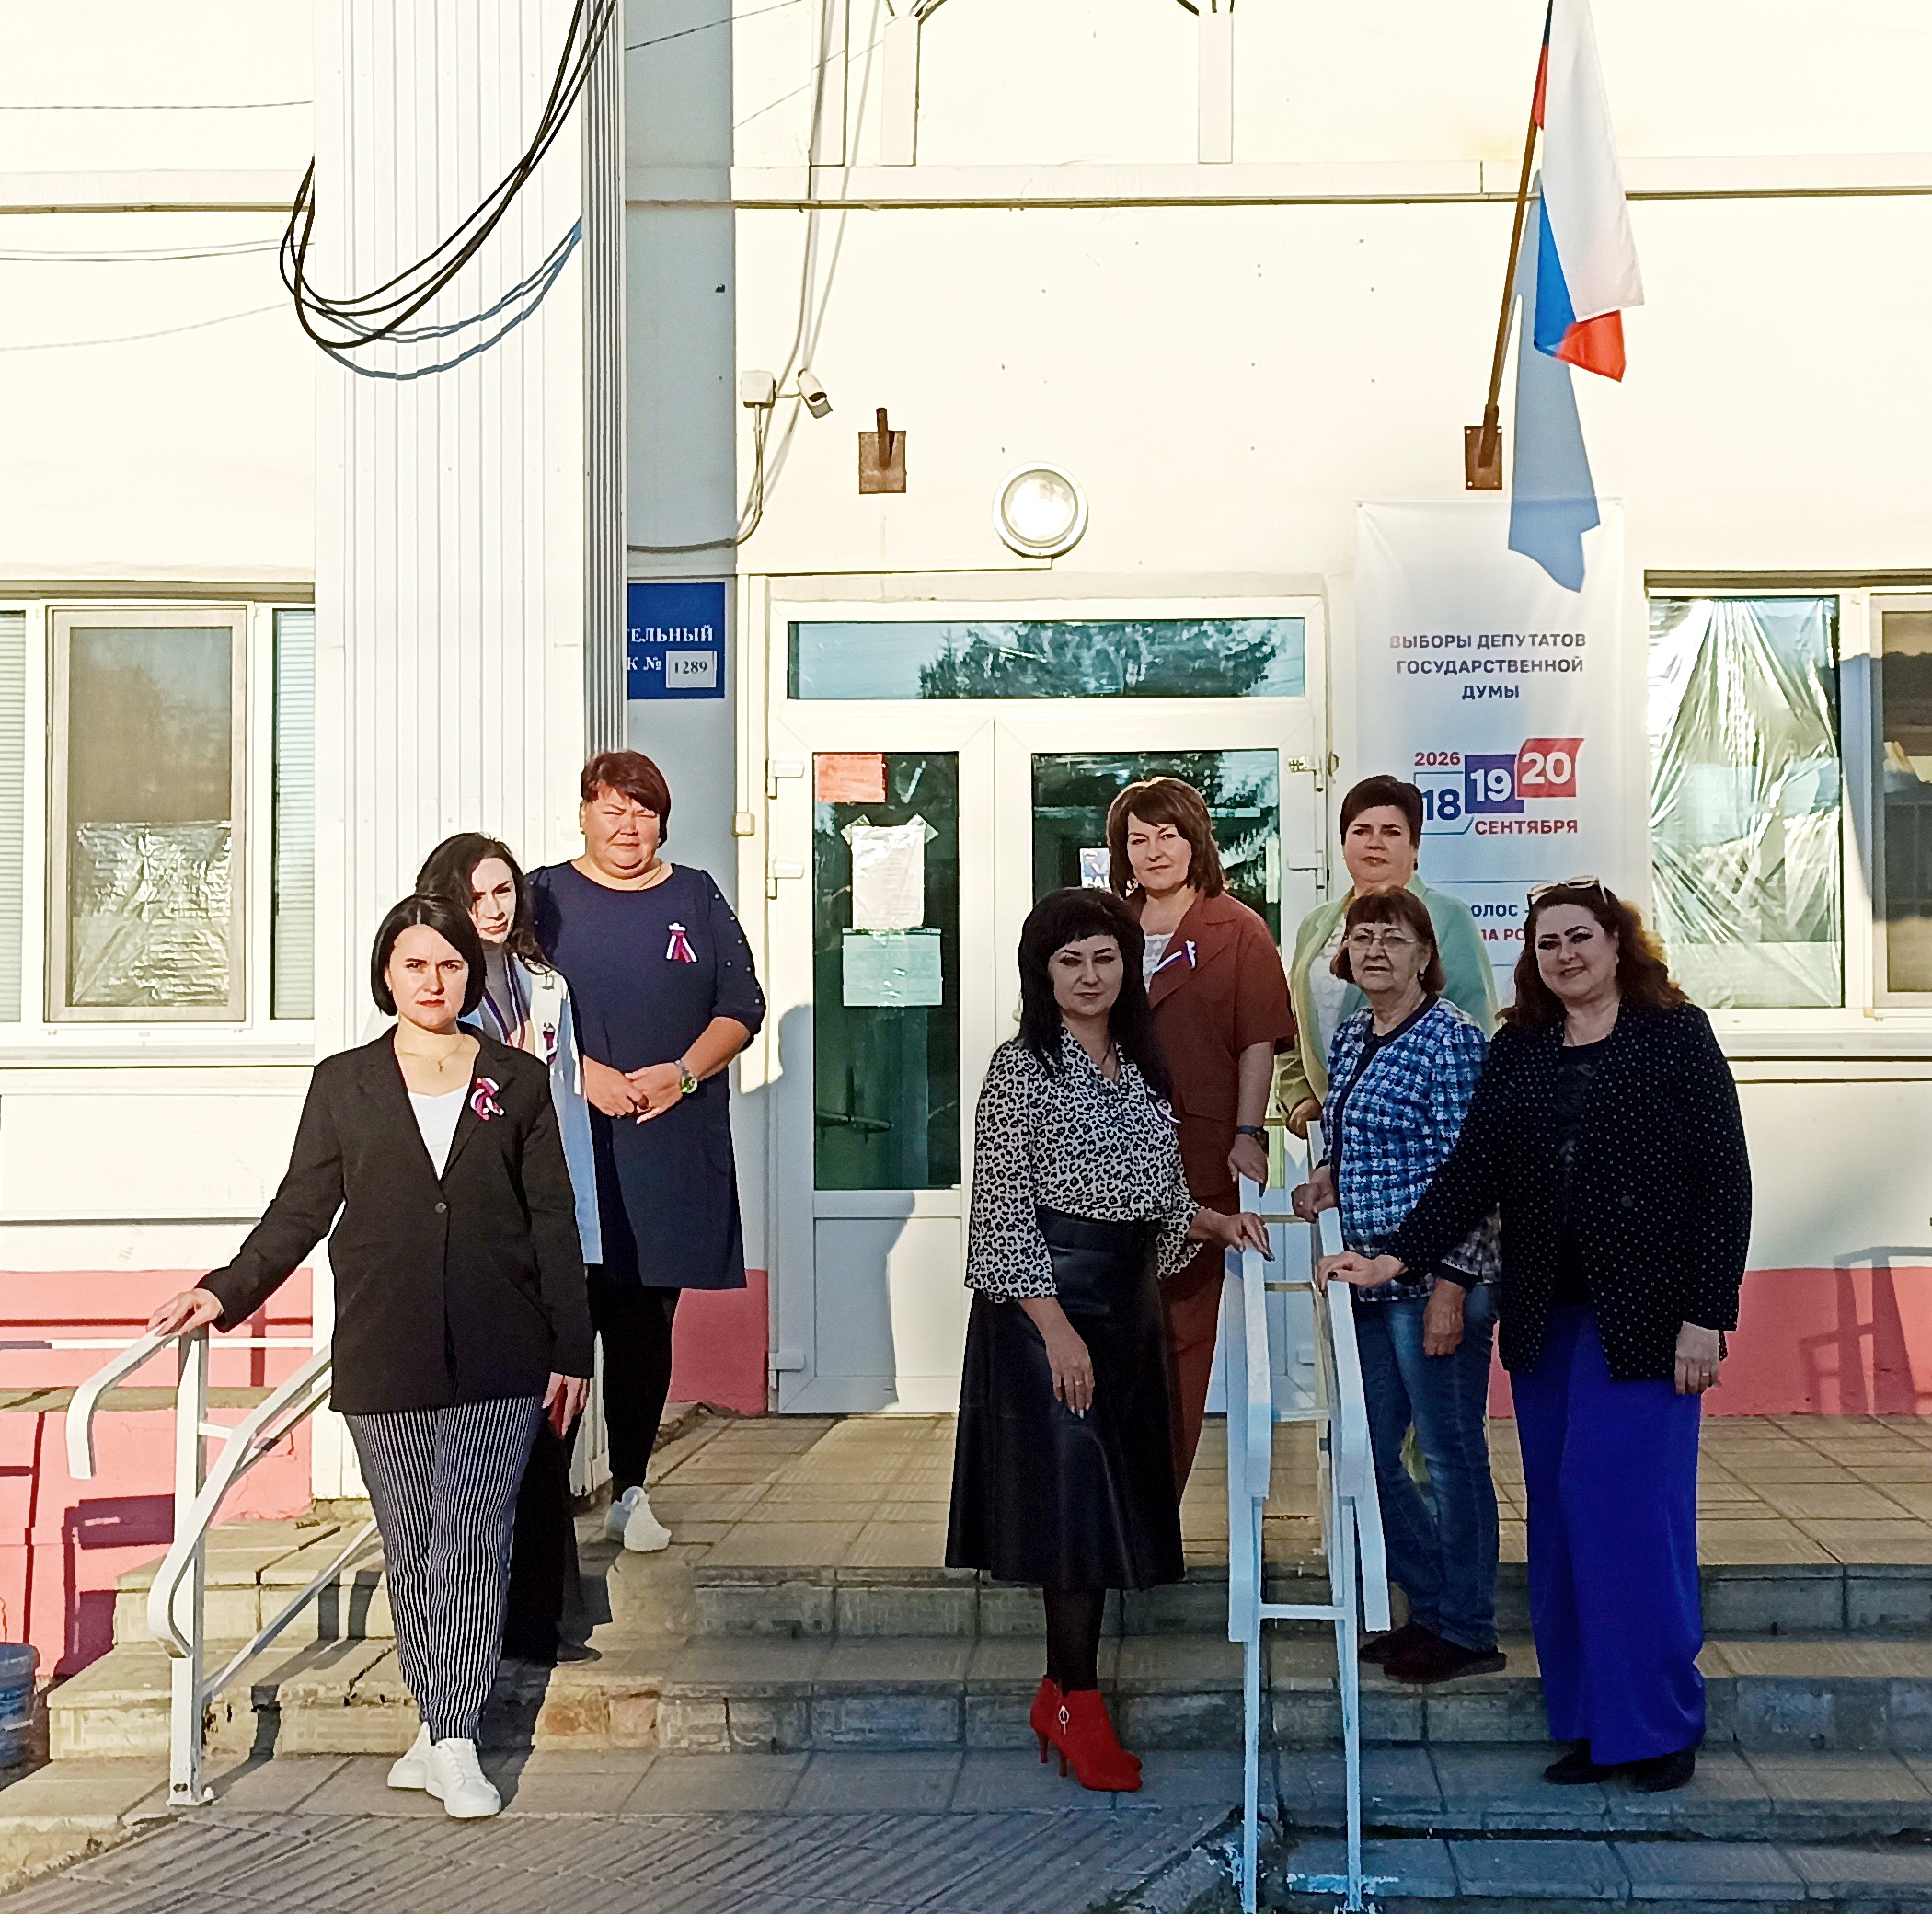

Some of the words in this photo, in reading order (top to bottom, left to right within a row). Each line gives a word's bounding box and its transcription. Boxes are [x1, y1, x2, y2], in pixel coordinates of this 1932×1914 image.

[627, 624, 713, 642] ЕЛЬНЫЙ
[1389, 634, 1472, 649] ВЫБОРЫ
[1477, 633, 1586, 650] ДЕПУТАТОВ
[643, 656, 661, 670] №
[674, 661, 707, 674] 1289
[1397, 656, 1583, 675] ГОСУДАРСТВЕННОЙ
[1462, 685, 1520, 700] ДУМЫ
[1414, 751, 1461, 767] 2026
[1423, 788, 1462, 821] 18
[1470, 768, 1512, 802] 19
[1521, 751, 1572, 784] 20
[1475, 819, 1578, 835] СЕНТЯБРЯ
